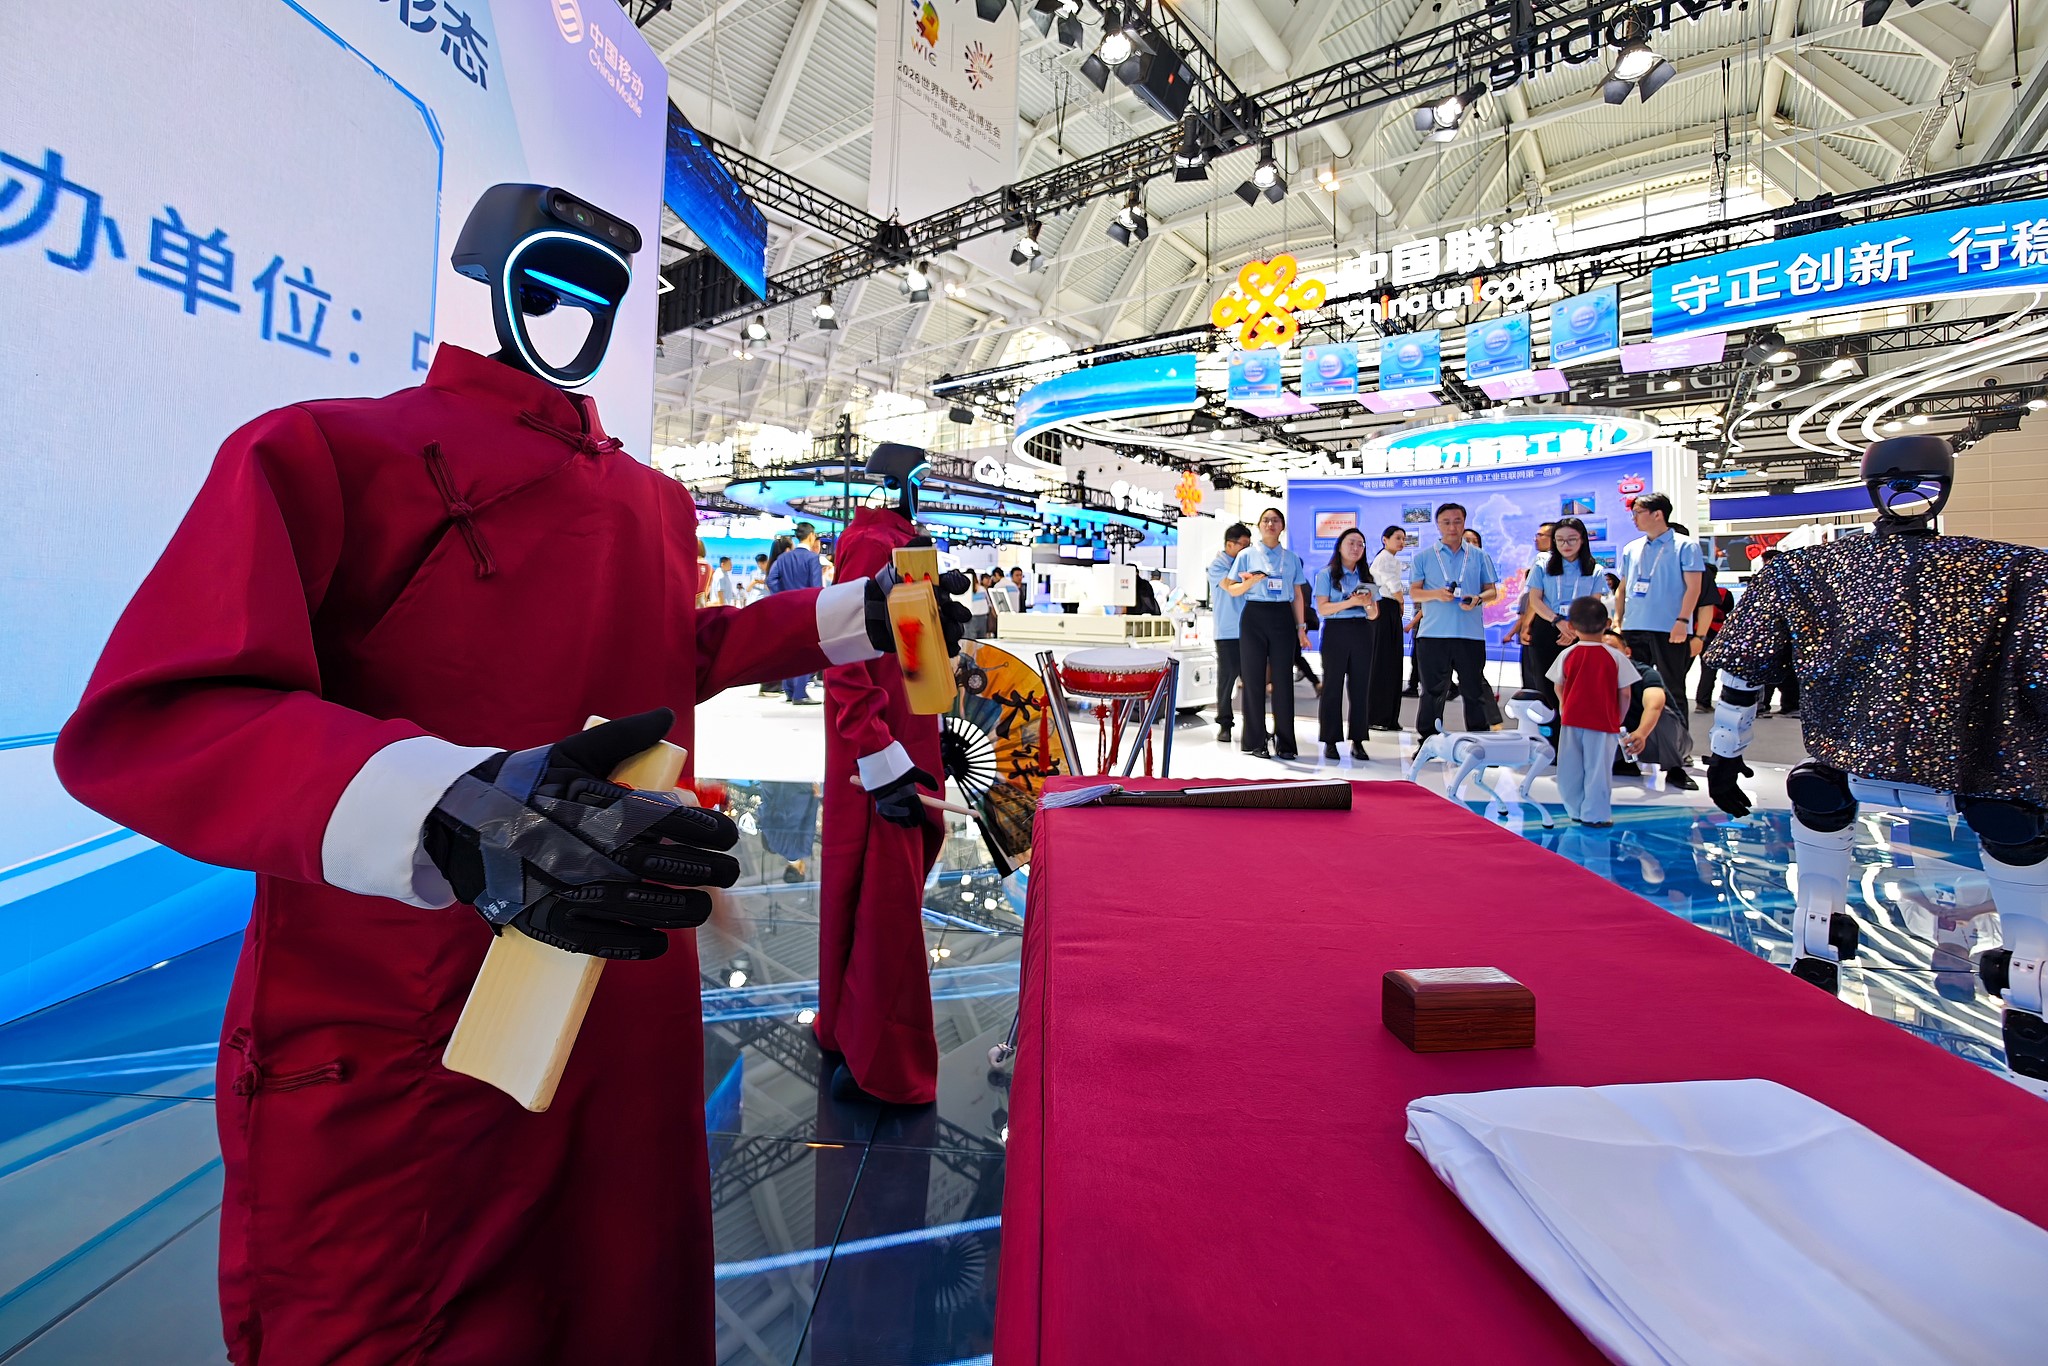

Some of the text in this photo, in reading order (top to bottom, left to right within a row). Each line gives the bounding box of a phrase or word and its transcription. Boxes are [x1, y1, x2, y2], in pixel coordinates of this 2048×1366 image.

[588, 48, 643, 118] China Mobile
[589, 22, 644, 101] 中国移动
[897, 75, 922, 97] WORLD
[911, 36, 938, 67] WIC
[1338, 212, 1560, 298] 中国联通
[1671, 218, 2048, 316] 守正创新 行稳
